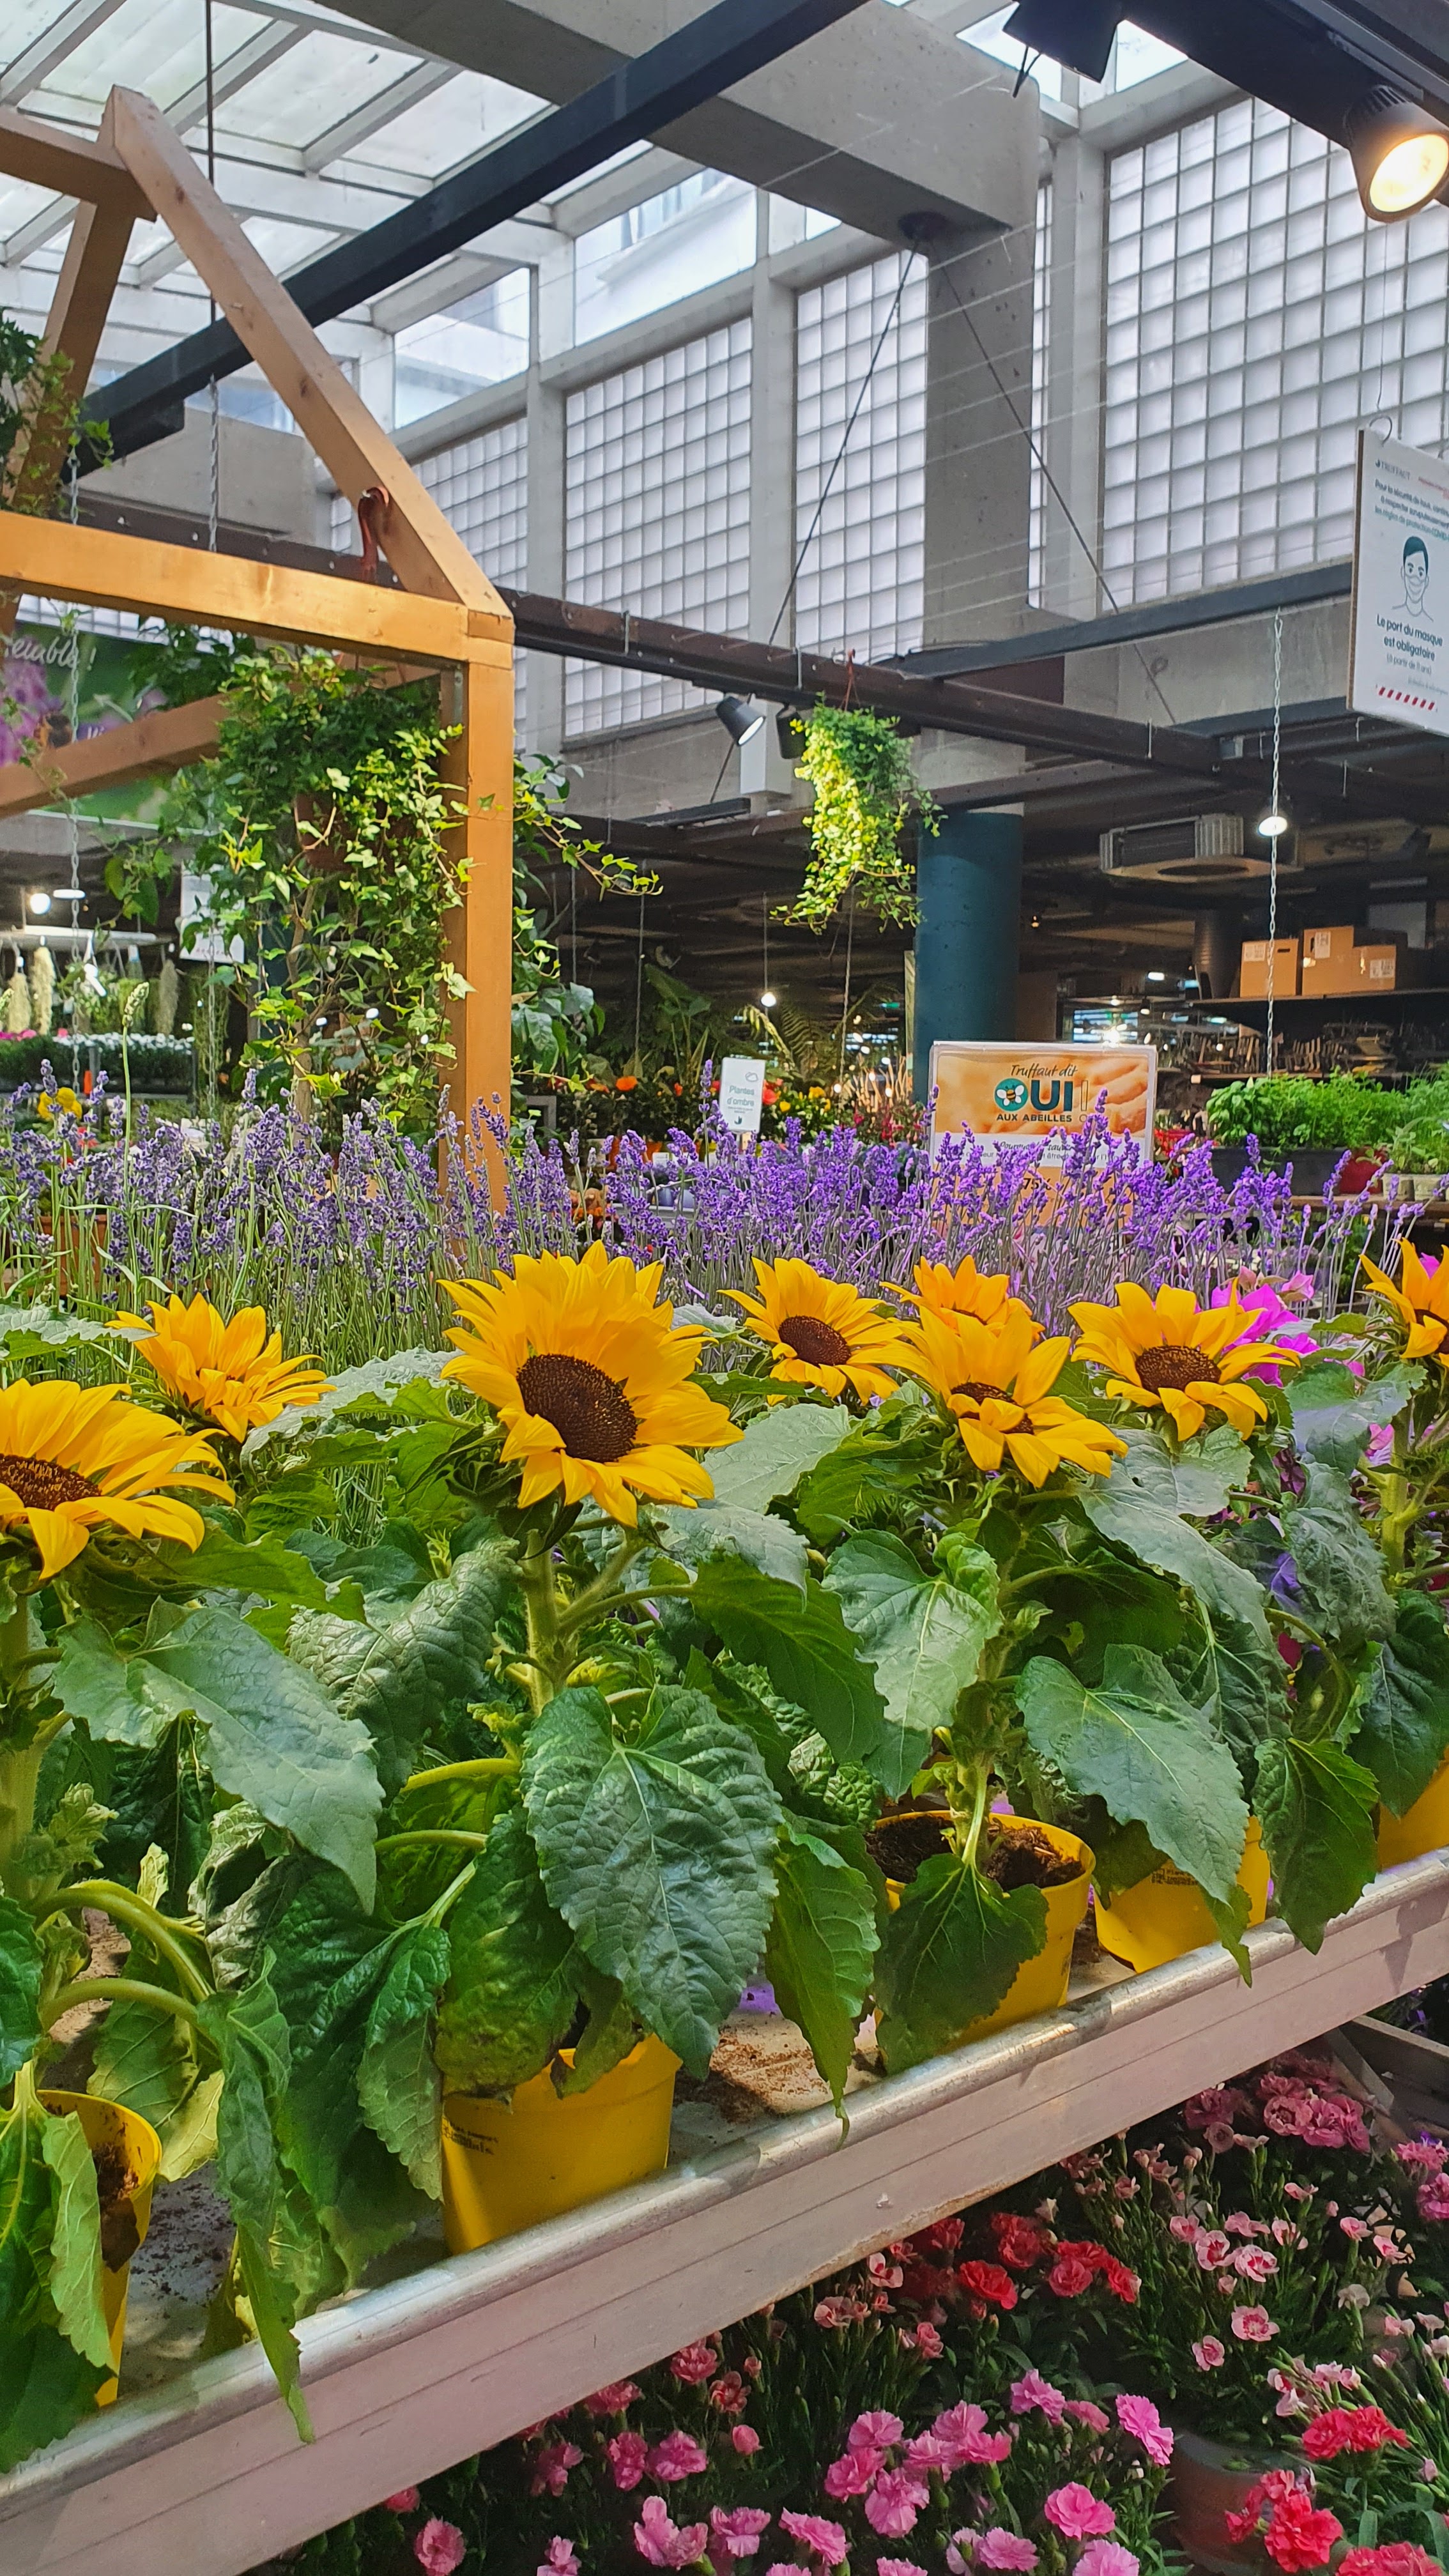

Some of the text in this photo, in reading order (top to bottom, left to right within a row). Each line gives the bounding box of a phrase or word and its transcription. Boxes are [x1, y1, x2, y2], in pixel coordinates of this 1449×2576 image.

[1377, 613, 1443, 647] Le port du masque
[1384, 636, 1435, 661] est obligatoire
[1011, 1063, 1078, 1078] Truffaut dit
[729, 1085, 755, 1096] Plantes
[726, 1096, 755, 1107] d'ombre
[1022, 1114, 1072, 1123] ABEILLES
